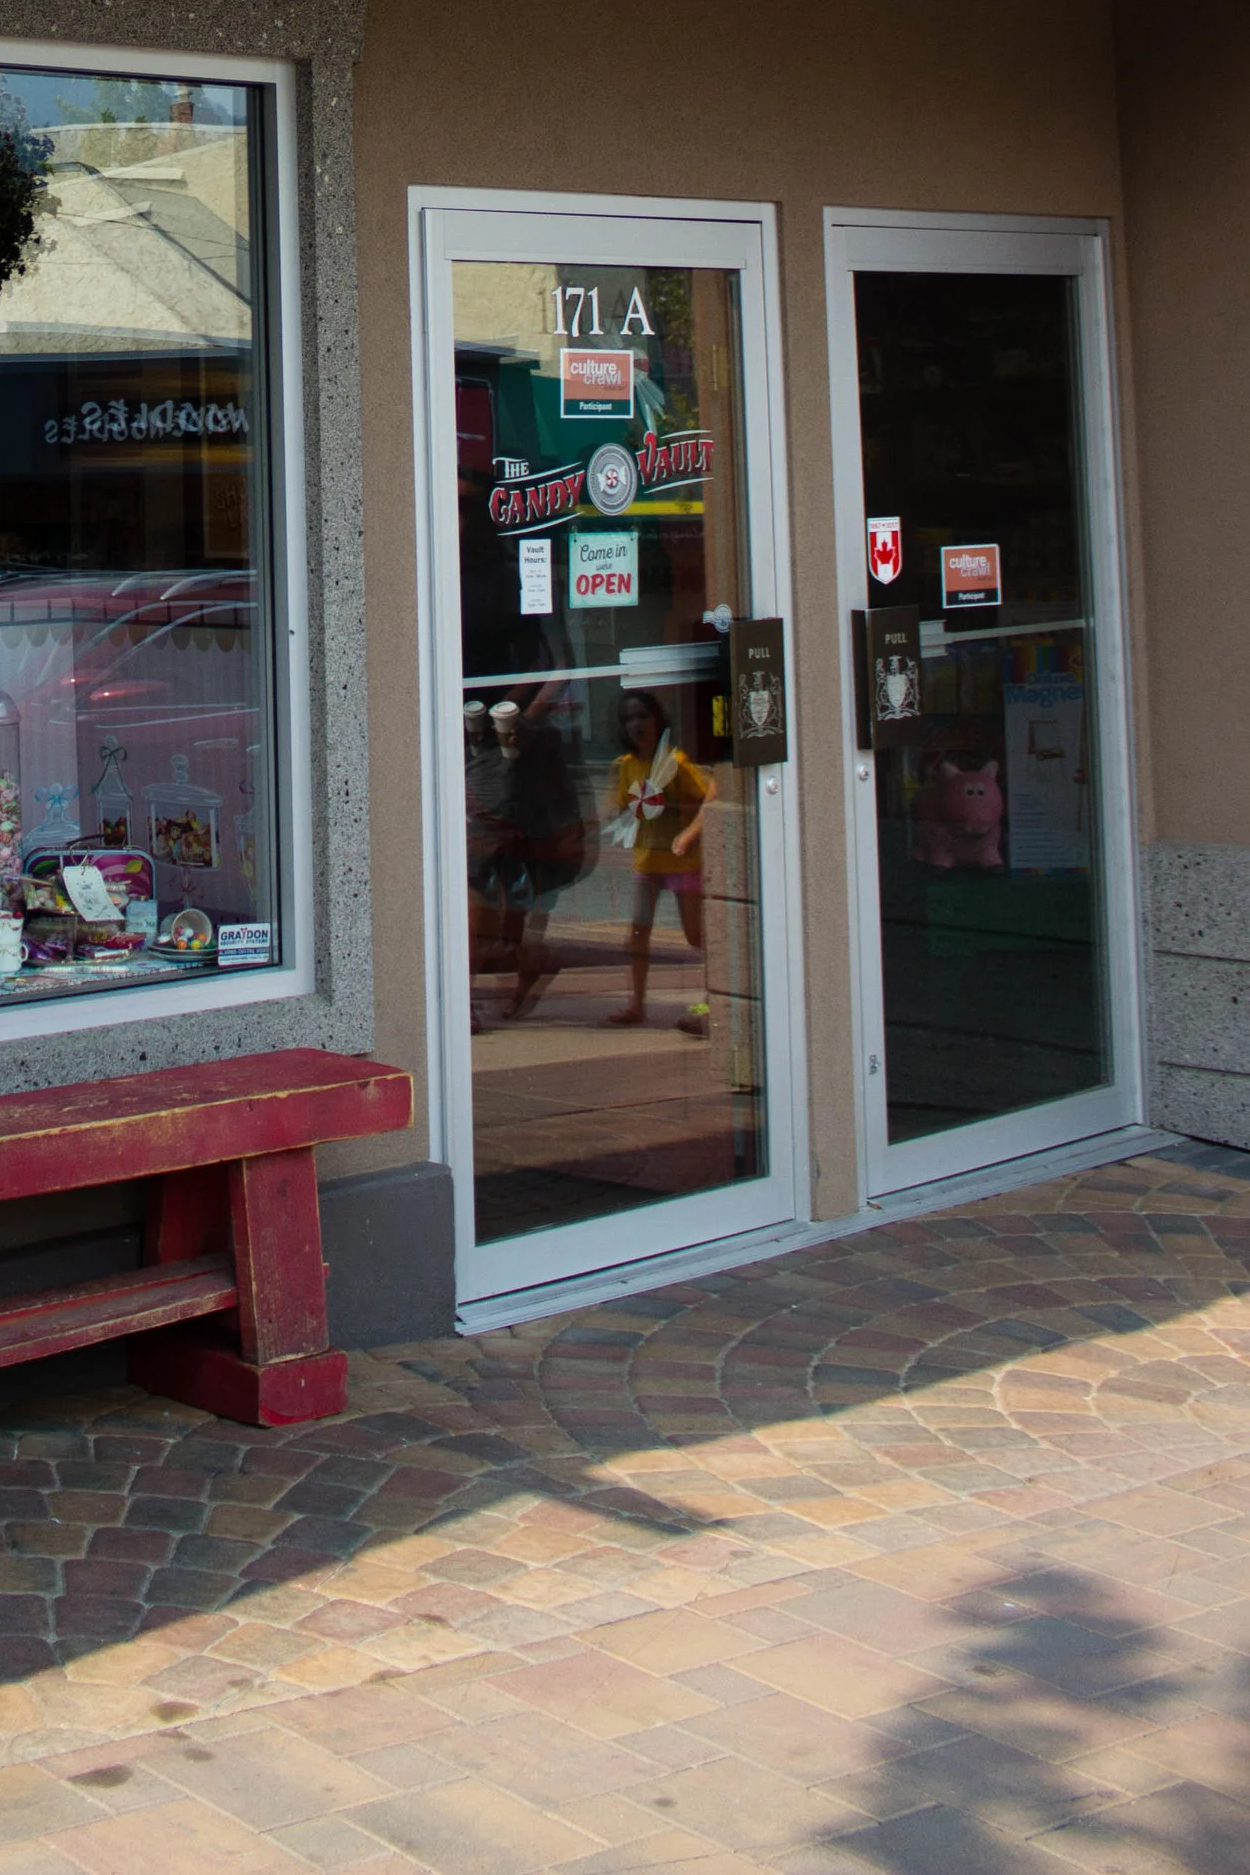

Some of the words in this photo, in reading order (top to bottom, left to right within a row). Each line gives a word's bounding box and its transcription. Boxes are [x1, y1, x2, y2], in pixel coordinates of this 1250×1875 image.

[552, 286, 604, 338] 171
[620, 286, 656, 336] A
[570, 359, 617, 374] culture
[584, 370, 622, 384] crawl
[579, 402, 613, 412] Participant
[635, 430, 714, 485] VAULT
[492, 457, 529, 478] THE
[489, 470, 586, 524] CANDY
[579, 544, 613, 562] Come
[615, 545, 627, 557] in
[949, 554, 988, 569] culture
[960, 566, 991, 577] crawl
[576, 573, 632, 596] OPEN
[884, 632, 907, 644] PULL
[748, 647, 771, 659] PULL
[220, 927, 268, 940] GRAYDON
